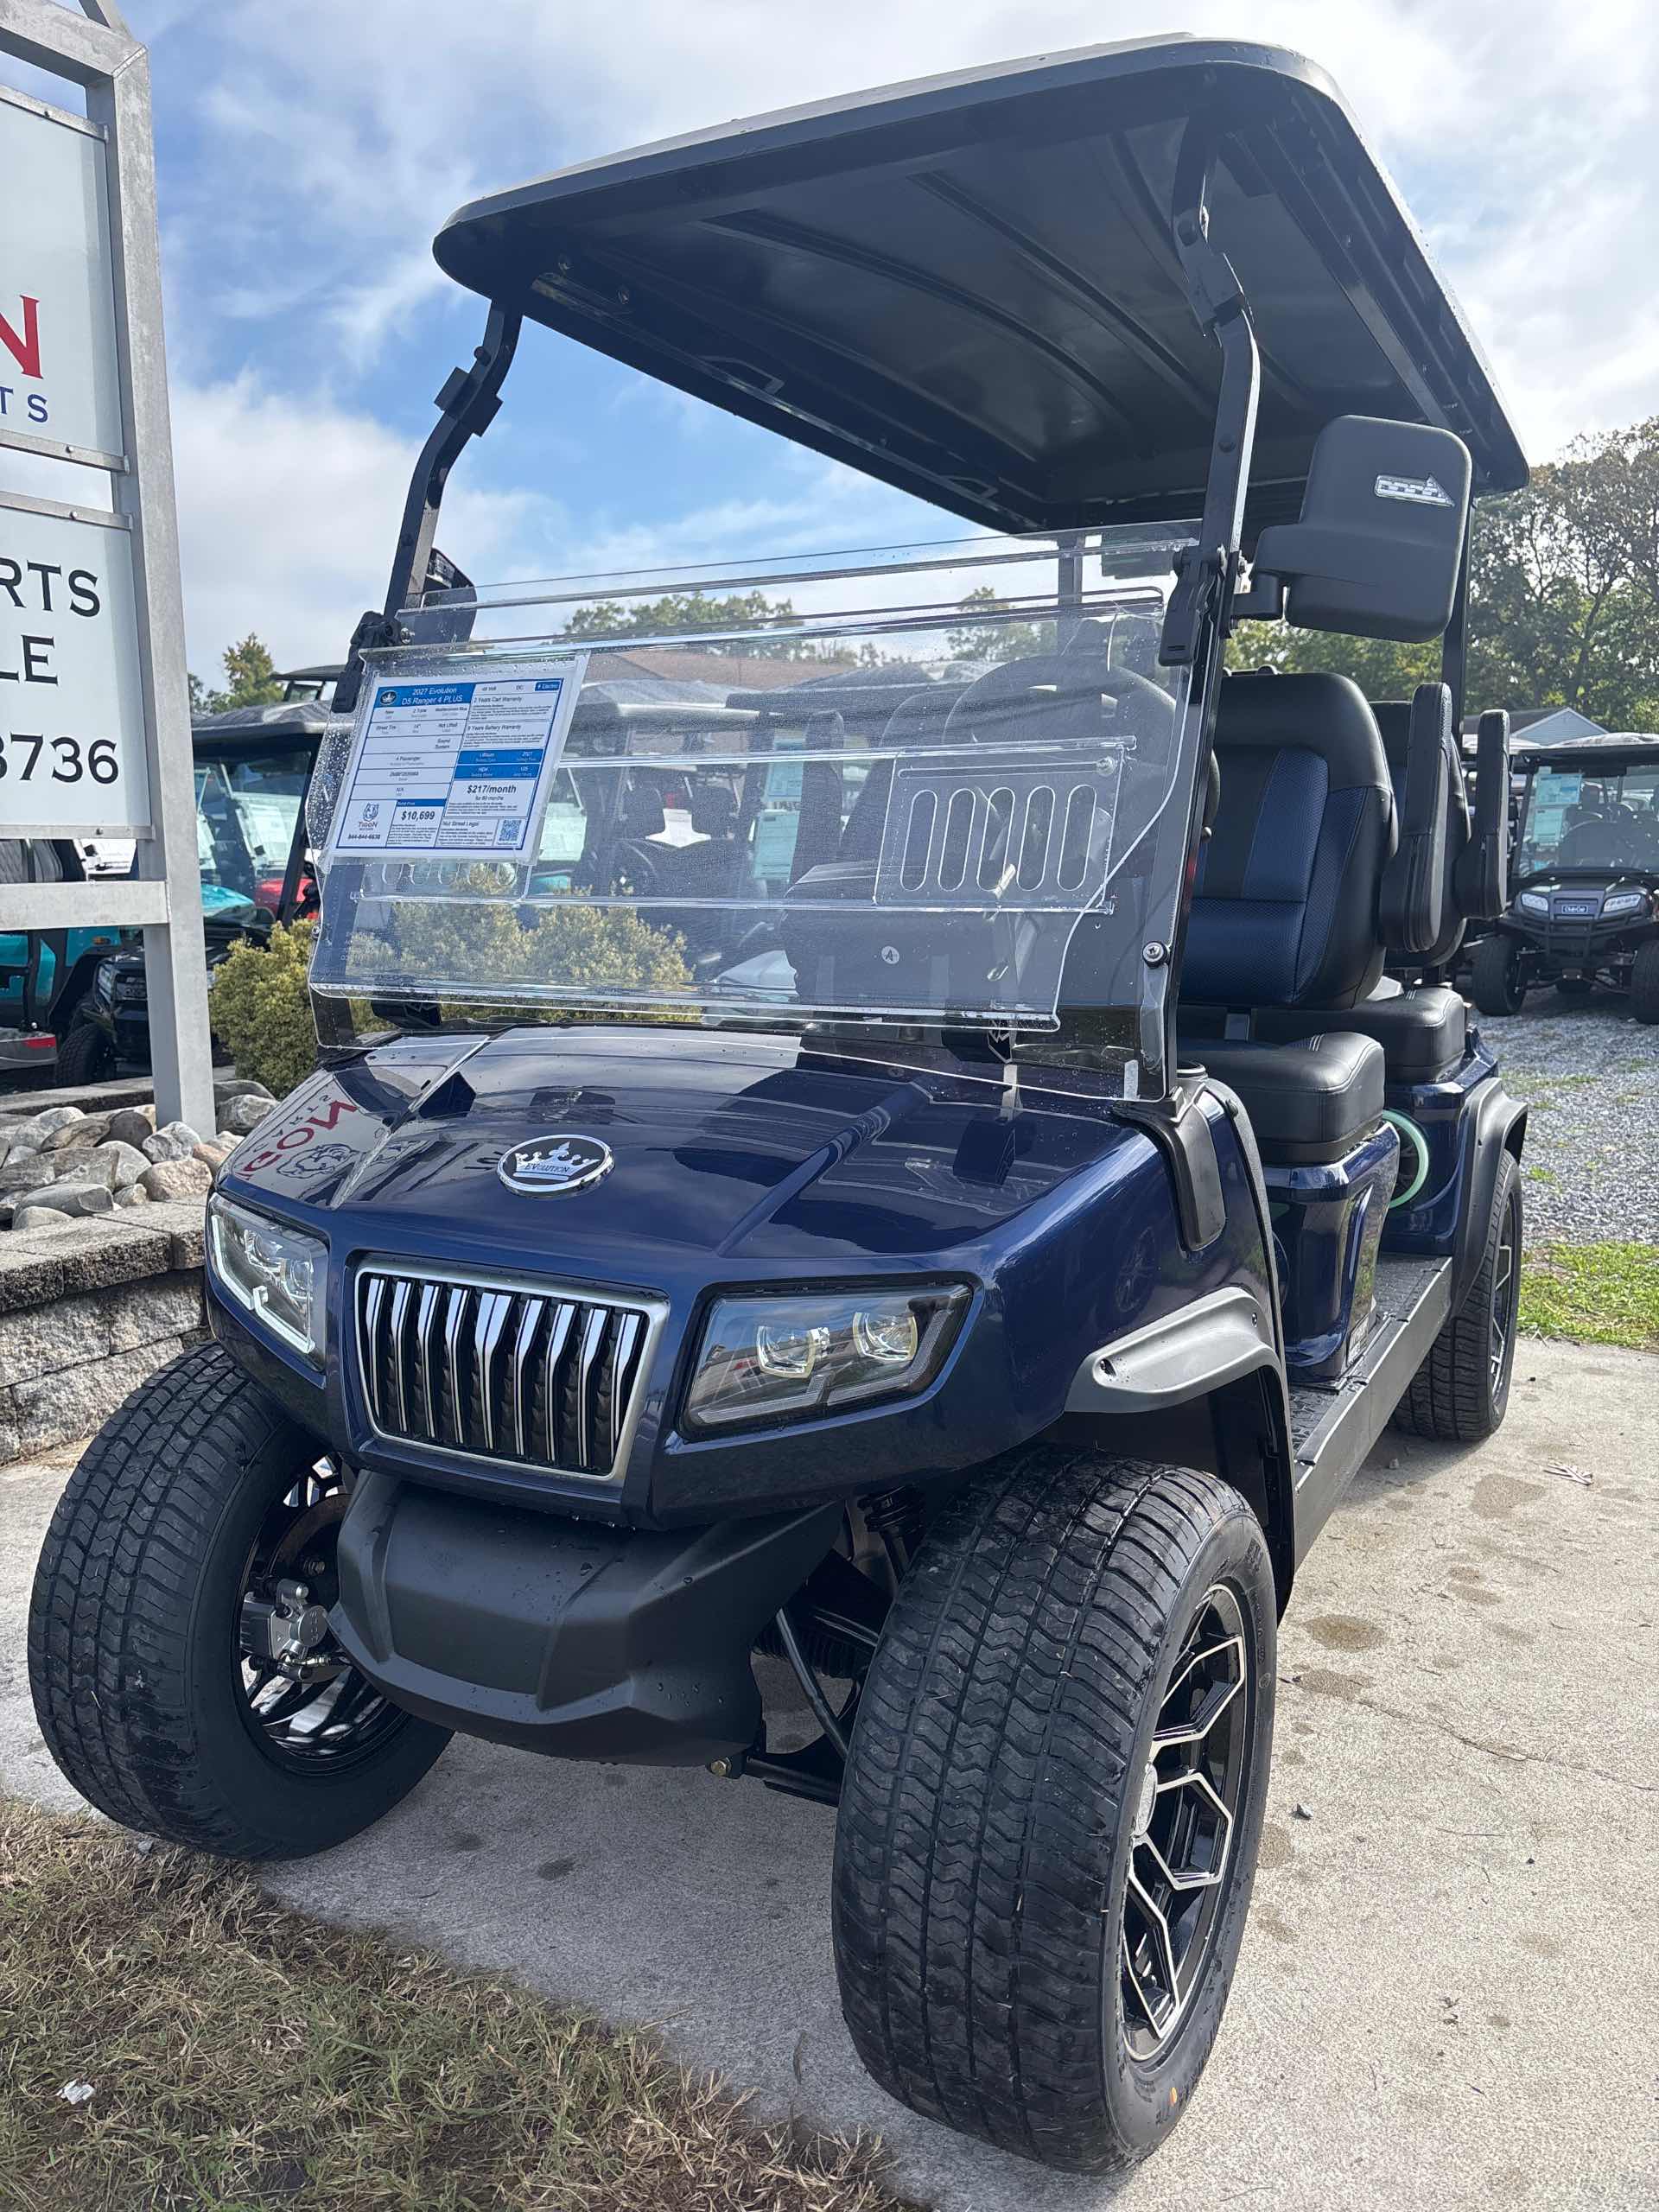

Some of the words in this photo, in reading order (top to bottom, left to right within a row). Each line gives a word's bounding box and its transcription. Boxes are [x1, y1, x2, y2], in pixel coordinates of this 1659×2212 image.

[412, 696, 435, 706] Ranger
[442, 695, 463, 703] PLUS
[0, 733, 119, 785] 736
[467, 785, 517, 794] $217/month
[401, 810, 435, 822] $10,699
